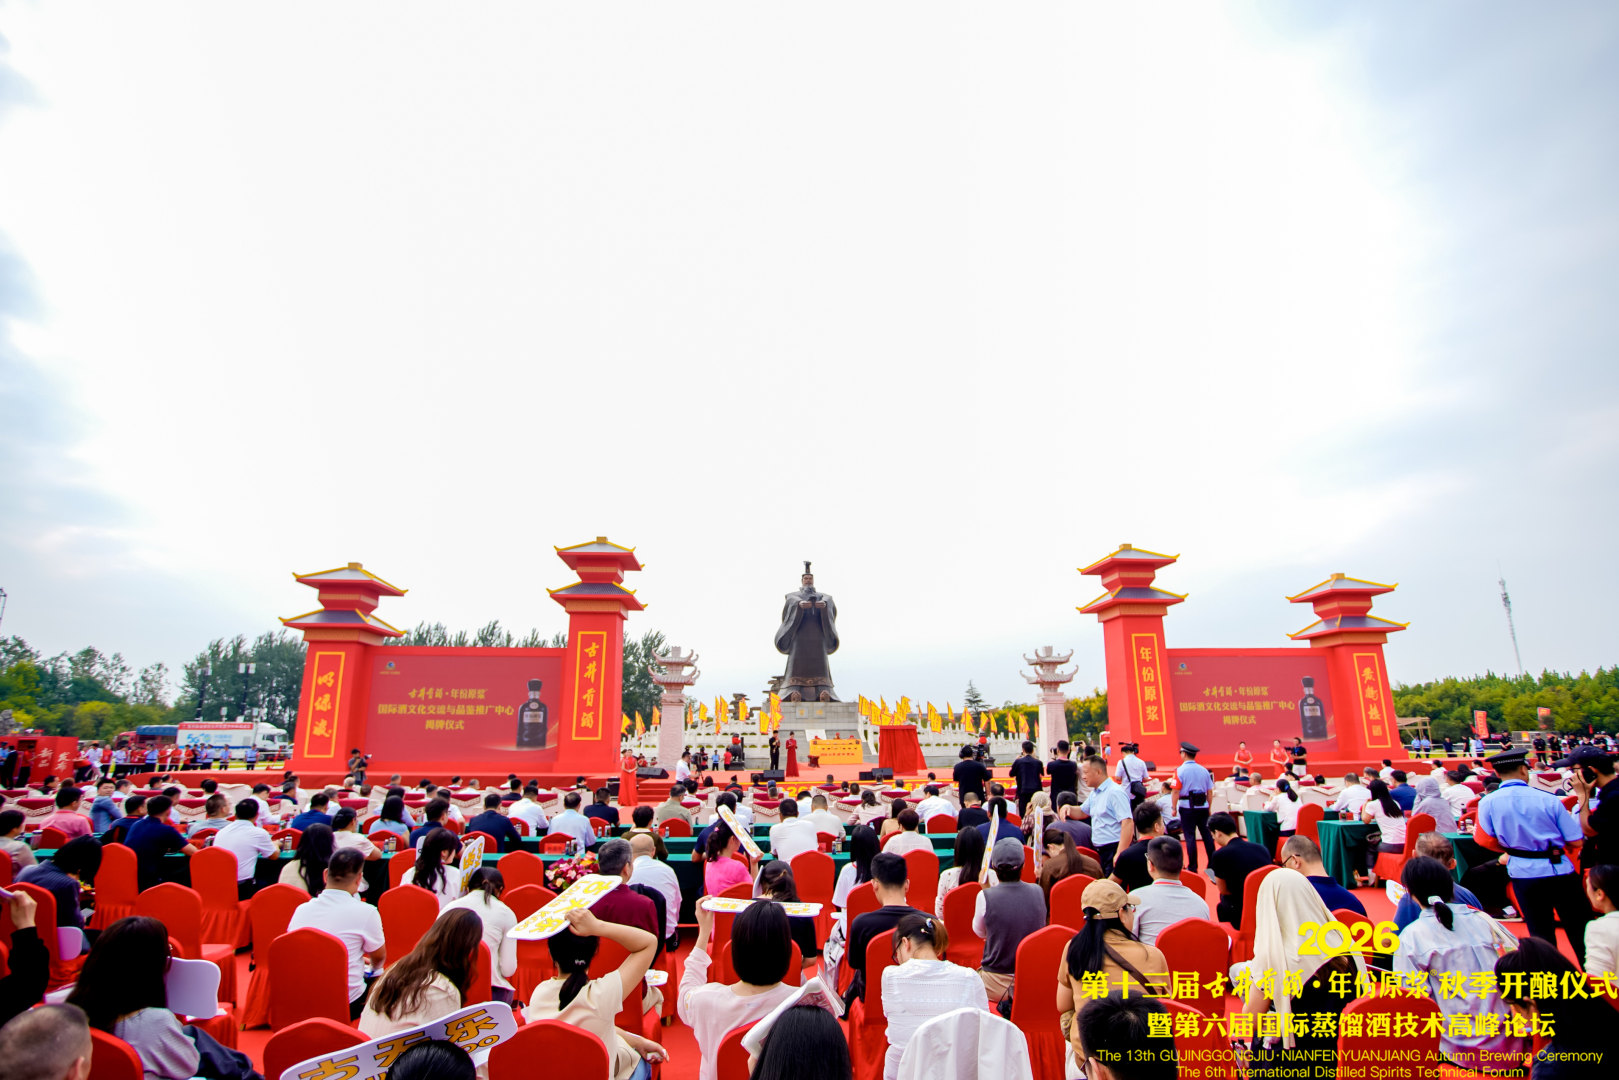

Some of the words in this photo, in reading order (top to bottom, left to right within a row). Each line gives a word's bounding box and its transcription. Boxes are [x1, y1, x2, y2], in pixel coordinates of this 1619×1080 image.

[580, 641, 600, 729] 古井贡酒
[1139, 646, 1160, 721] 年份原浆
